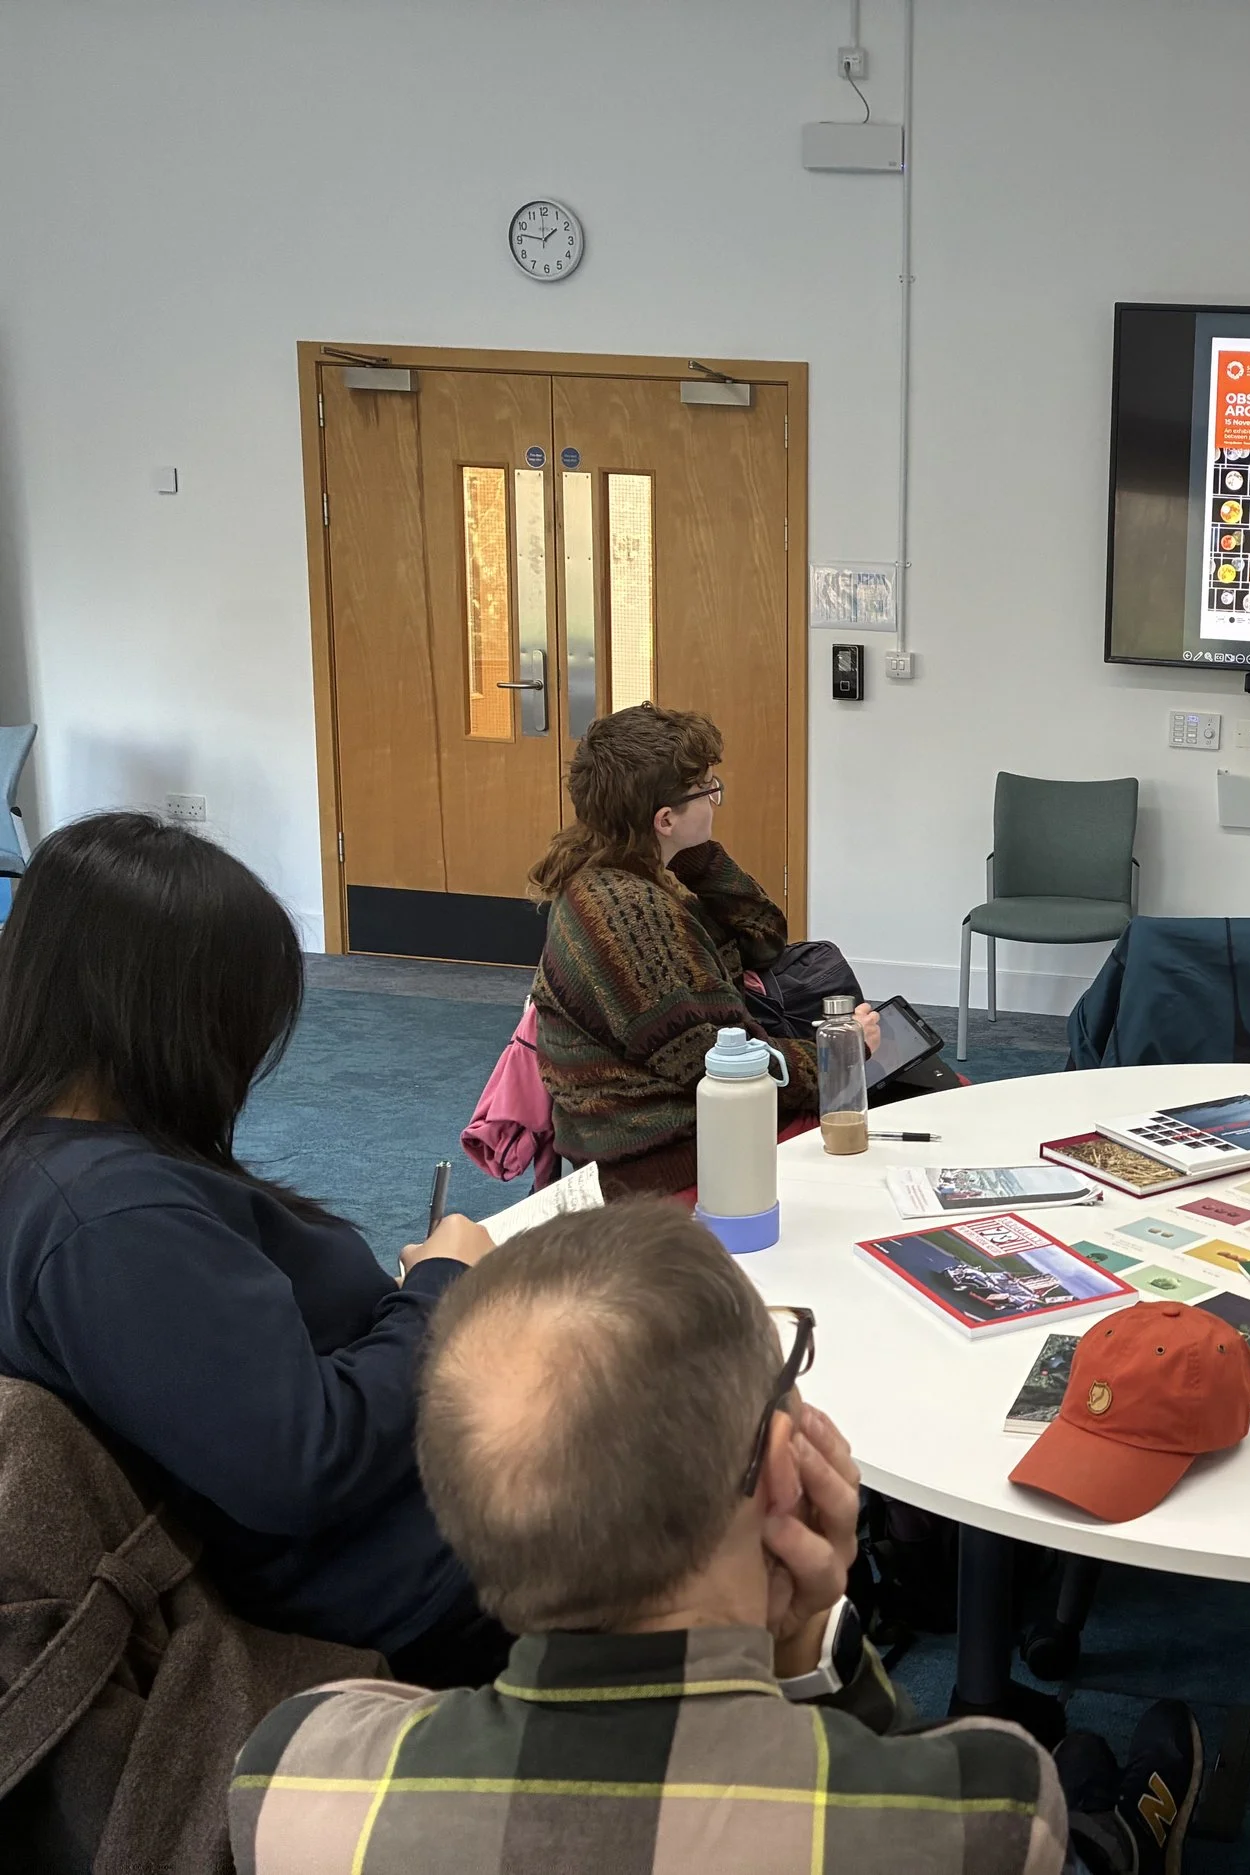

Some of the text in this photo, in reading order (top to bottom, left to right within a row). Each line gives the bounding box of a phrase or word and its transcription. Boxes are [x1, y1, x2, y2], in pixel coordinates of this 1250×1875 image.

[528, 211, 536, 220] 11
[540, 207, 549, 217] 12
[555, 211, 559, 220] 1
[518, 221, 527, 231] 10
[563, 221, 570, 232] 2
[516, 235, 523, 245] 9
[567, 236, 574, 246] 3
[521, 249, 527, 259] 8
[565, 250, 571, 260] 4
[530, 260, 537, 270] 7
[543, 264, 550, 273] 6
[556, 260, 563, 270] 5
[1137, 1771, 1178, 1848] N
